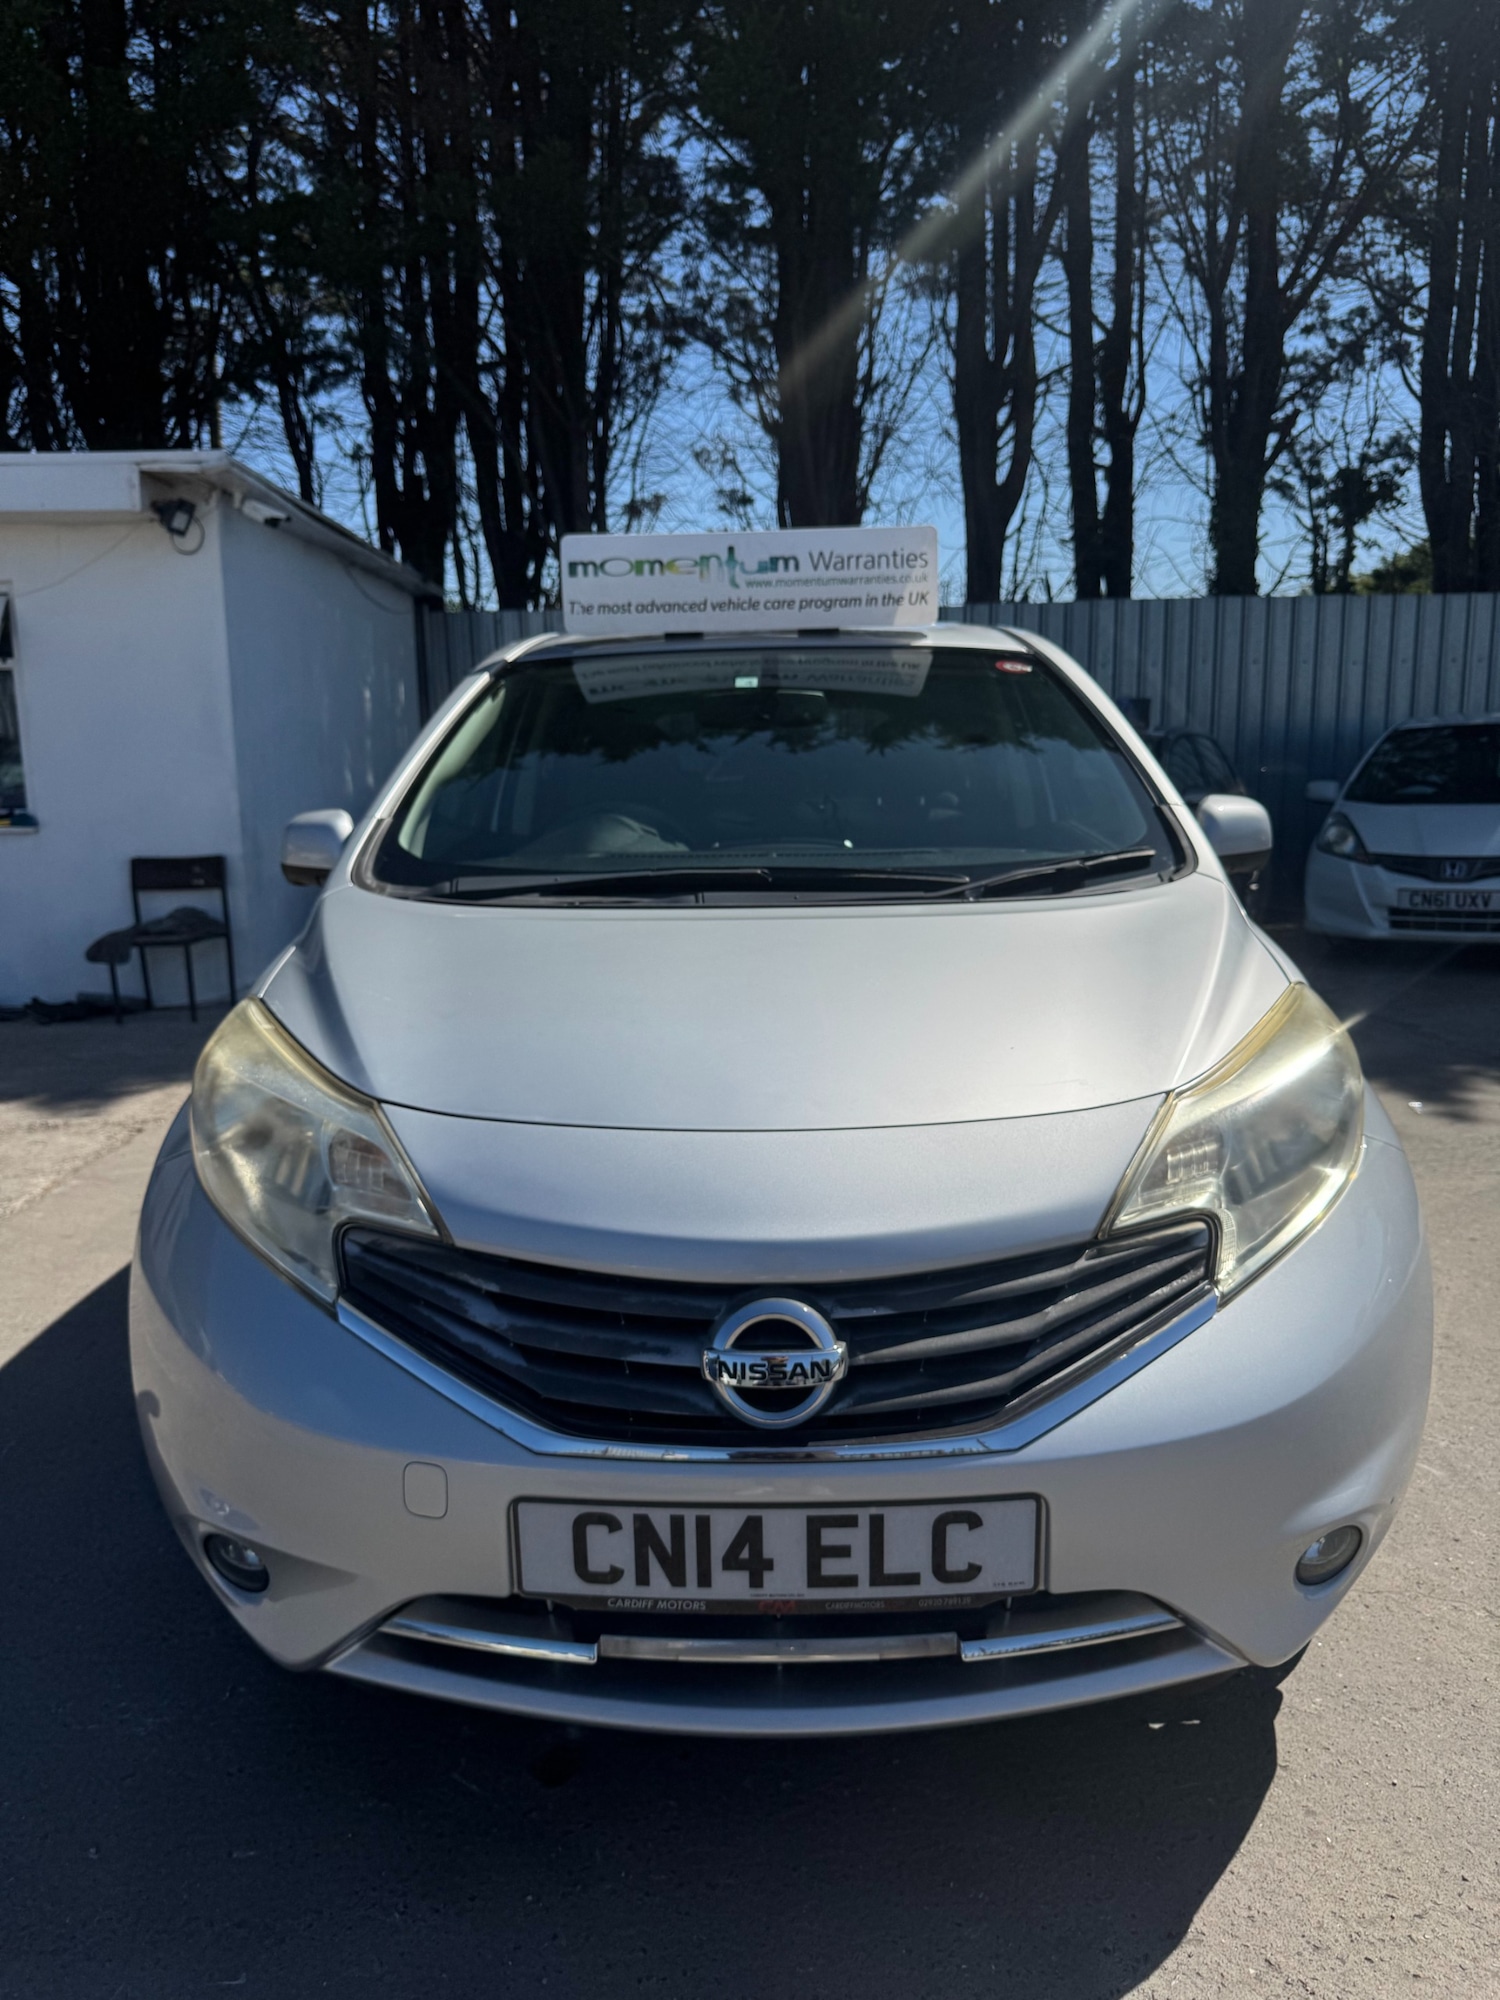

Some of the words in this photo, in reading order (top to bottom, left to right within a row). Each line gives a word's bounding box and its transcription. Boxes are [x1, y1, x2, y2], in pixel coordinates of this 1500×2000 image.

[568, 545, 799, 590] momentum
[809, 550, 928, 572] Warranties
[745, 573, 929, 589] www.momentumwarranties.co.uk
[597, 601, 631, 615] most
[635, 597, 708, 615] advanced
[710, 596, 760, 612] vehicle
[763, 599, 796, 611] care
[798, 595, 862, 613] program
[865, 593, 878, 607] in
[881, 592, 904, 607] the
[908, 591, 930, 606] UK
[1409, 890, 1450, 907] CN61
[718, 1359, 830, 1381] NISSAN
[572, 1511, 774, 1589] CN14
[806, 1510, 984, 1589] ELC
[607, 1598, 654, 1609] CARDIFF
[656, 1599, 707, 1611] MOTORS
